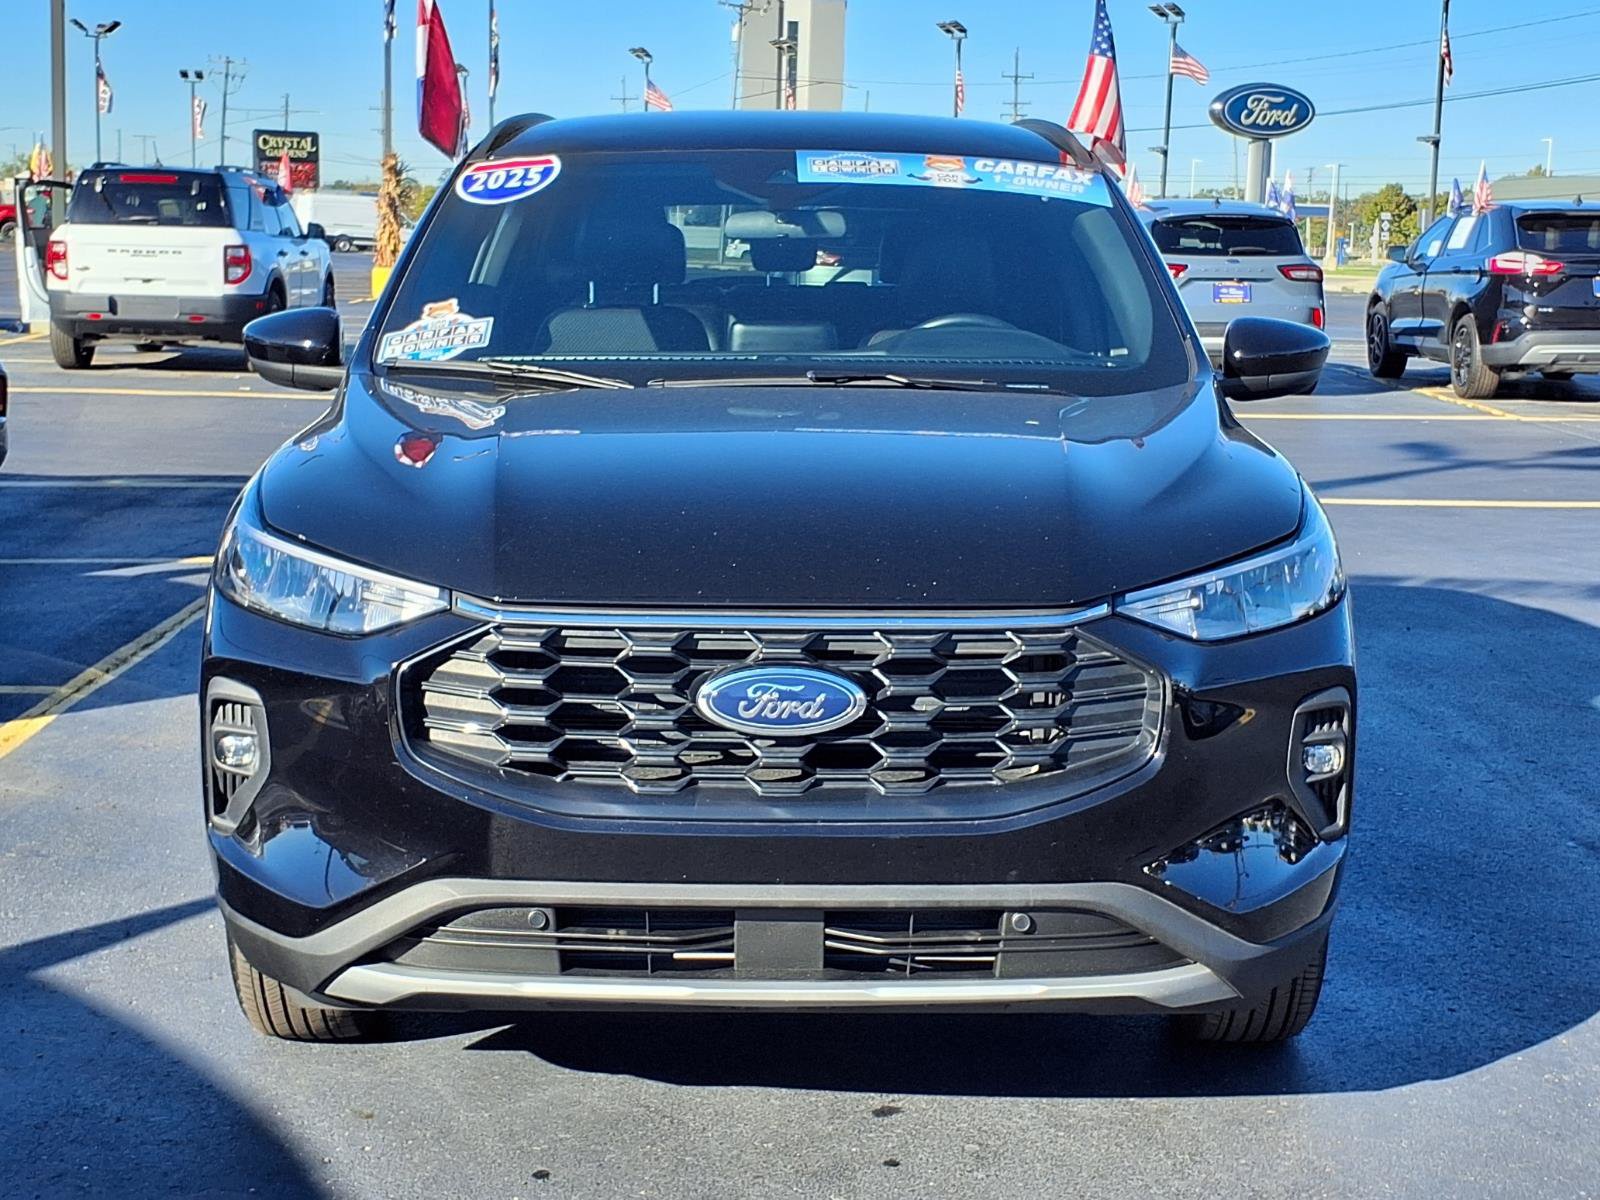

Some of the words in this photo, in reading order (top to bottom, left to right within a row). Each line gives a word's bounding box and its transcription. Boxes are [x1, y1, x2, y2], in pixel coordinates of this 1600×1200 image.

[1241, 94, 1298, 126] Ford
[258, 134, 317, 152] CRYSTAL
[467, 166, 544, 193] 2025
[973, 158, 1094, 186] CARFAX
[390, 325, 483, 345] CARFAX
[738, 682, 828, 720] Ford
